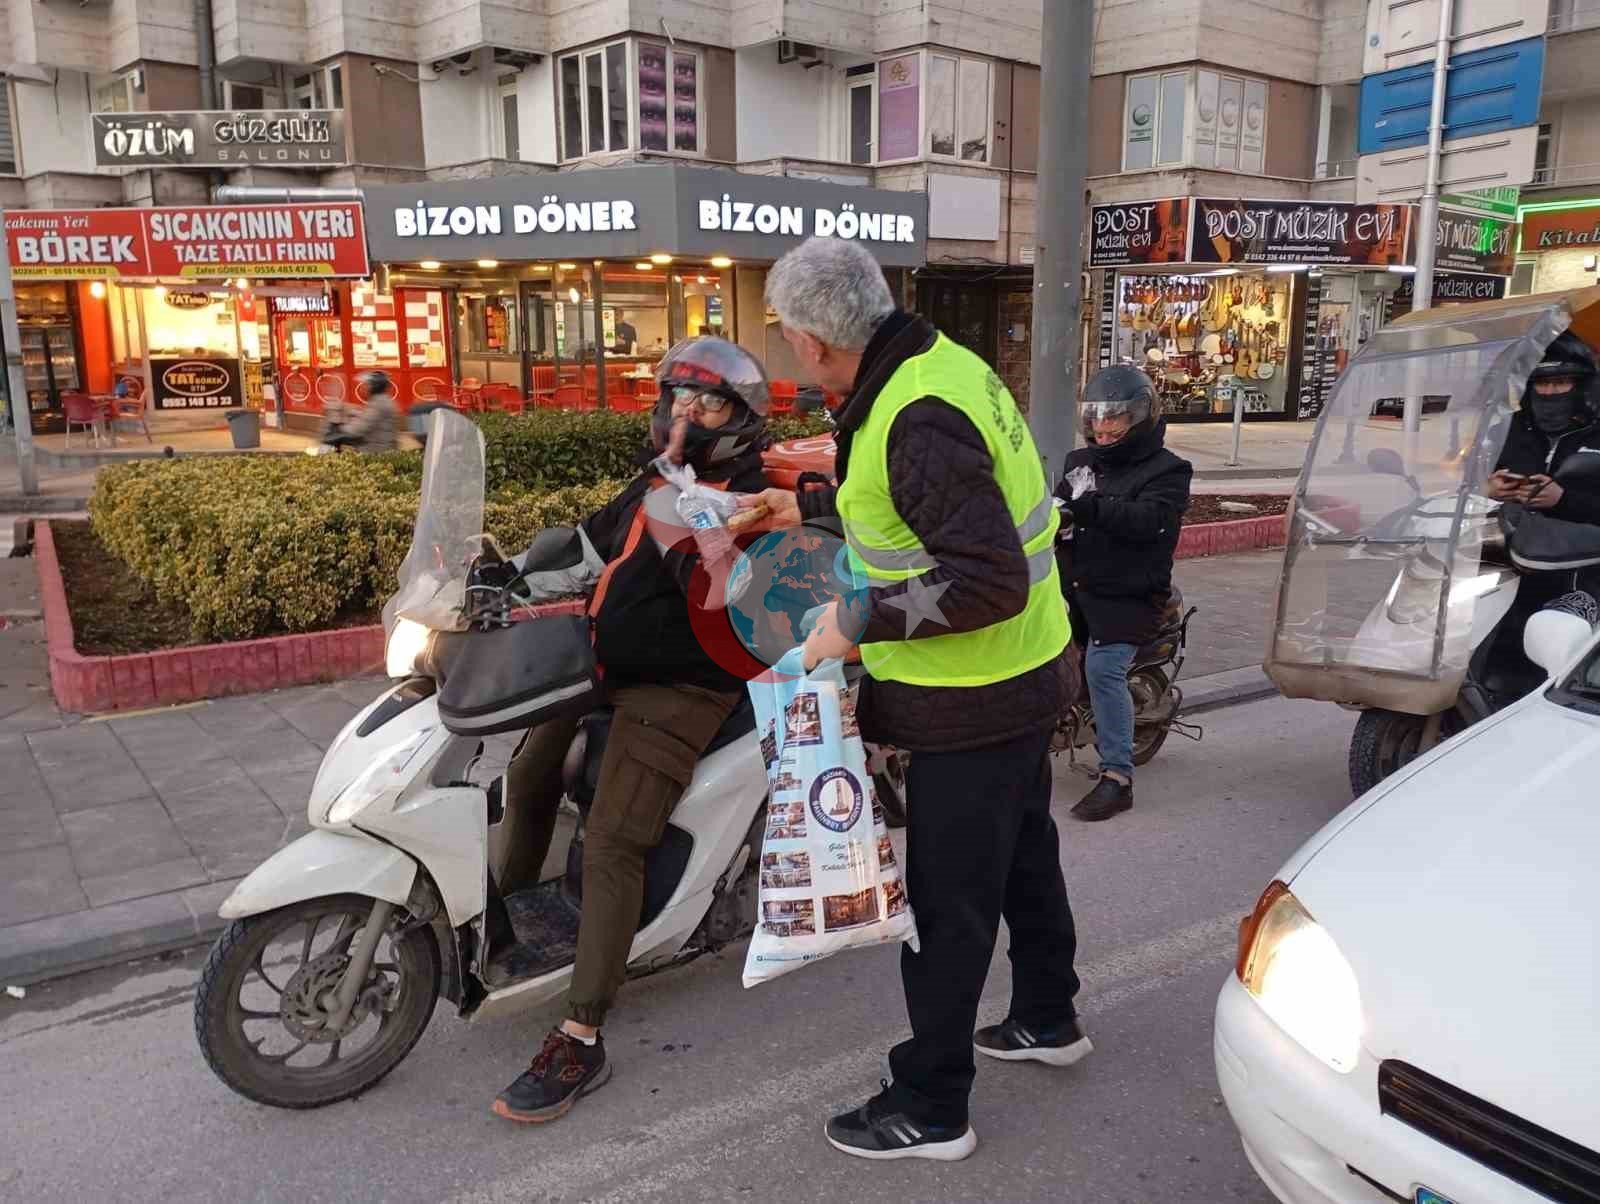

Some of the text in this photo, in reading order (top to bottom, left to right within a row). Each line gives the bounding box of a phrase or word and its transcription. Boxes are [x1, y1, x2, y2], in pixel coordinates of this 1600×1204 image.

[104, 121, 195, 156] ÖZÜM
[218, 149, 331, 160] SALONU
[150, 211, 293, 242] SICAKCININ
[395, 195, 636, 237] BİZON DÖNER
[699, 193, 914, 243] BİZON DÖNER
[1094, 204, 1156, 234] DOST
[1206, 208, 1273, 240] DOST
[1274, 206, 1350, 243] MÜZİK
[16, 230, 139, 263] BÖREK
[173, 242, 336, 262] TAZE TATLI FIRINI
